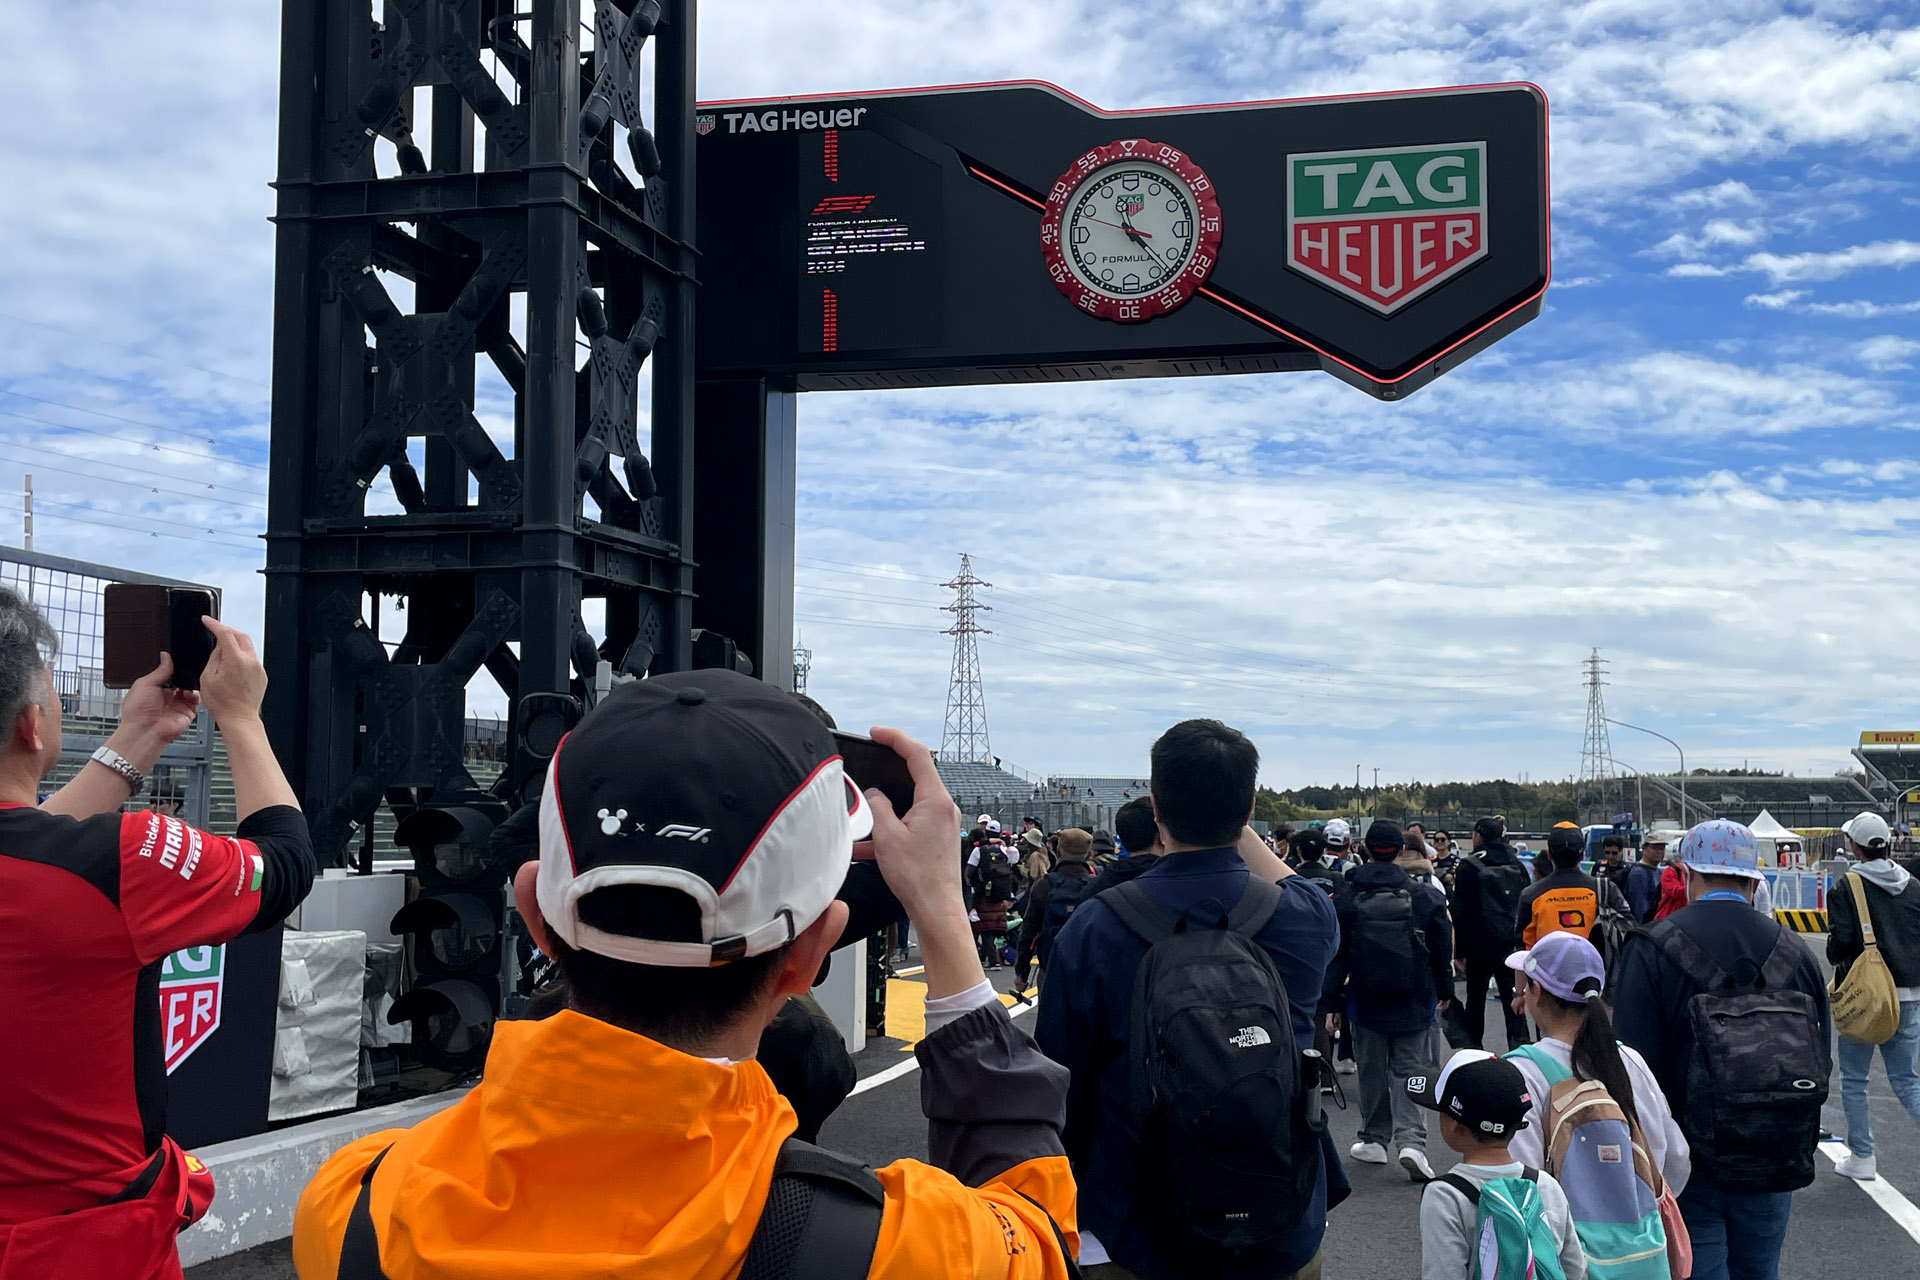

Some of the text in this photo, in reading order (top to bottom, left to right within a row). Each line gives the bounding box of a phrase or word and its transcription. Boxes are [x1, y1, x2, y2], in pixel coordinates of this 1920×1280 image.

[1078, 152, 1098, 169] 55
[1159, 146, 1182, 163] 05
[1193, 174, 1210, 192] 10
[1304, 156, 1467, 210] TAG
[1050, 182, 1067, 203] 50
[1207, 216, 1219, 232] 15
[1042, 223, 1053, 245] 45
[1102, 254, 1154, 264] FORMULA
[1192, 256, 1212, 278] 20
[1301, 219, 1473, 298] HEUER
[1050, 263, 1066, 284] 40
[1078, 294, 1100, 312] 35
[1160, 292, 1182, 309] 25
[1120, 306, 1140, 319] 30
[1875, 733, 1915, 742] PIRELLI
[139, 814, 160, 858] Bitdefe
[1546, 894, 1589, 902] McLaren
[1229, 1034, 1256, 1044] NORTH
[1238, 1028, 1255, 1036] THE
